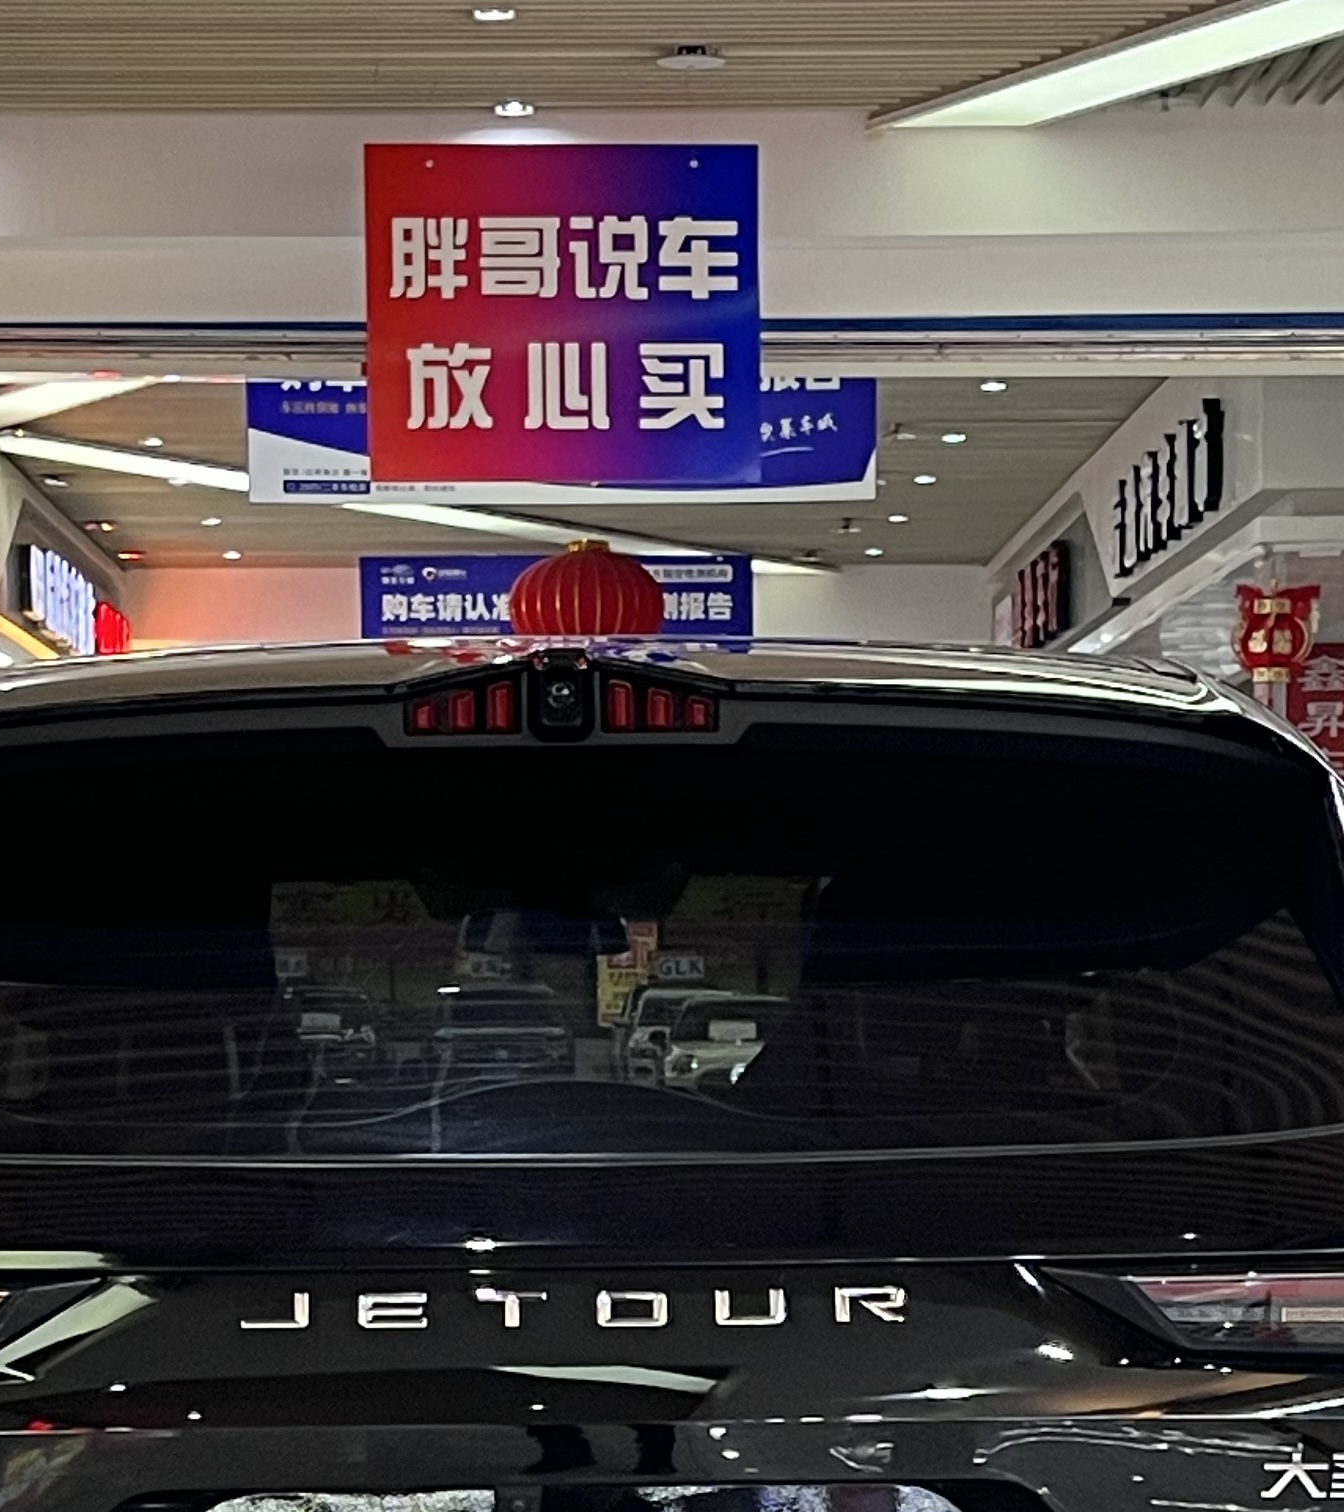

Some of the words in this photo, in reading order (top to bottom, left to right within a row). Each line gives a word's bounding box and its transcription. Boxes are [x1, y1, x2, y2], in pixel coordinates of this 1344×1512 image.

[390, 216, 739, 300] 胖哥说车
[406, 343, 725, 431] 放心买
[240, 1285, 906, 1329] JETOUR
